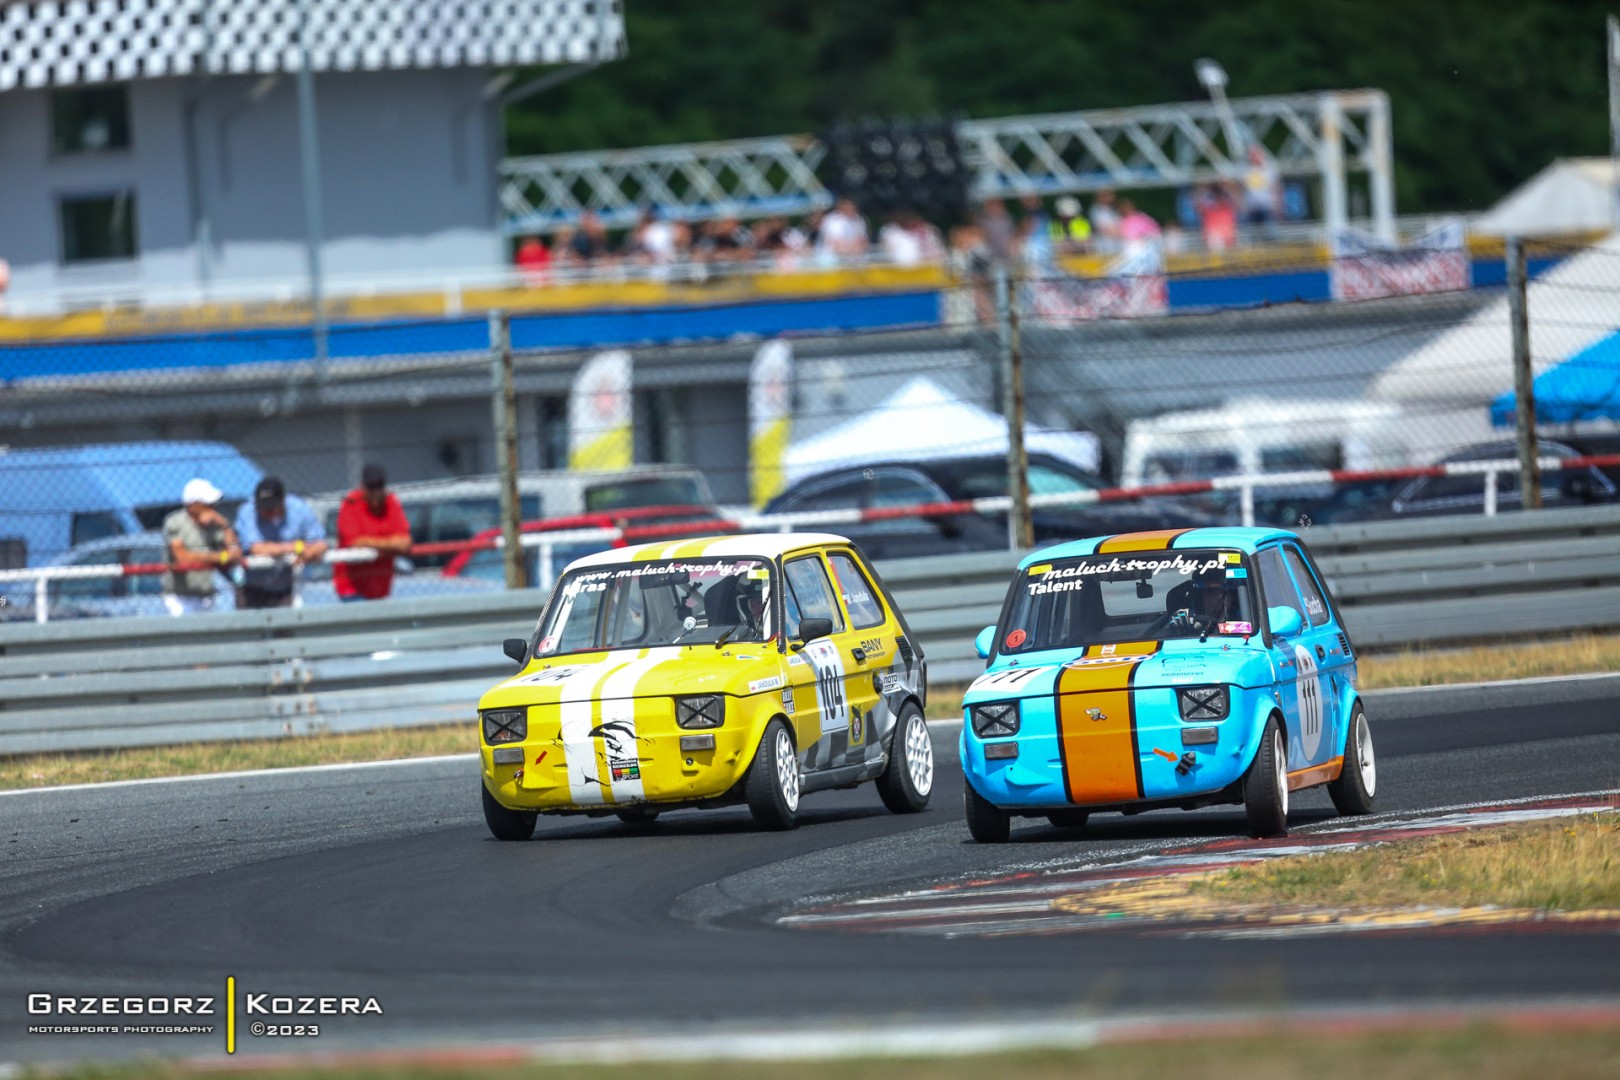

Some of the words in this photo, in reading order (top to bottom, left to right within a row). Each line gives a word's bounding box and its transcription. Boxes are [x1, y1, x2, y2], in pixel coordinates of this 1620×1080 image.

[574, 561, 757, 583] www.maluch-trophy.pl
[1042, 554, 1226, 580] maluch-trophy.pl
[1028, 578, 1082, 596] Talent
[819, 664, 845, 721] 104
[1302, 678, 1318, 736] 111
